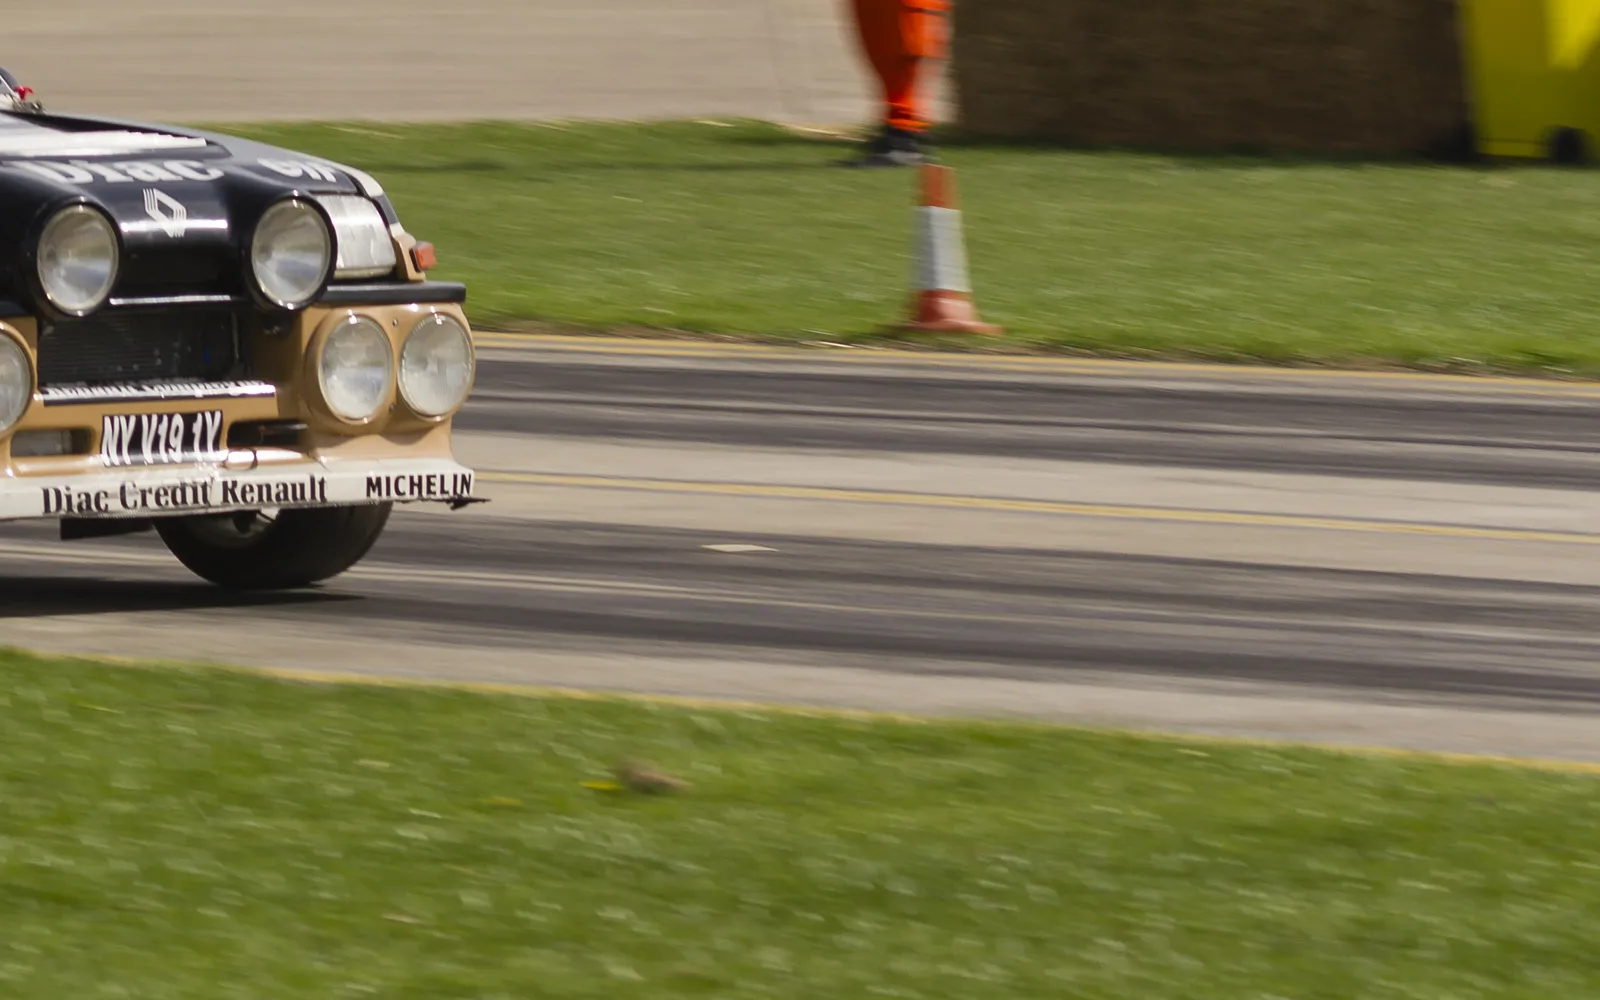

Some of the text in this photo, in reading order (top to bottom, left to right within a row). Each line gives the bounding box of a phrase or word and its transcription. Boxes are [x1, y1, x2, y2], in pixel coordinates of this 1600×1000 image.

[4, 159, 225, 185] Diac
[42, 485, 109, 514] Diac
[221, 474, 327, 505] Renault
[366, 473, 472, 498] MICHELIN
